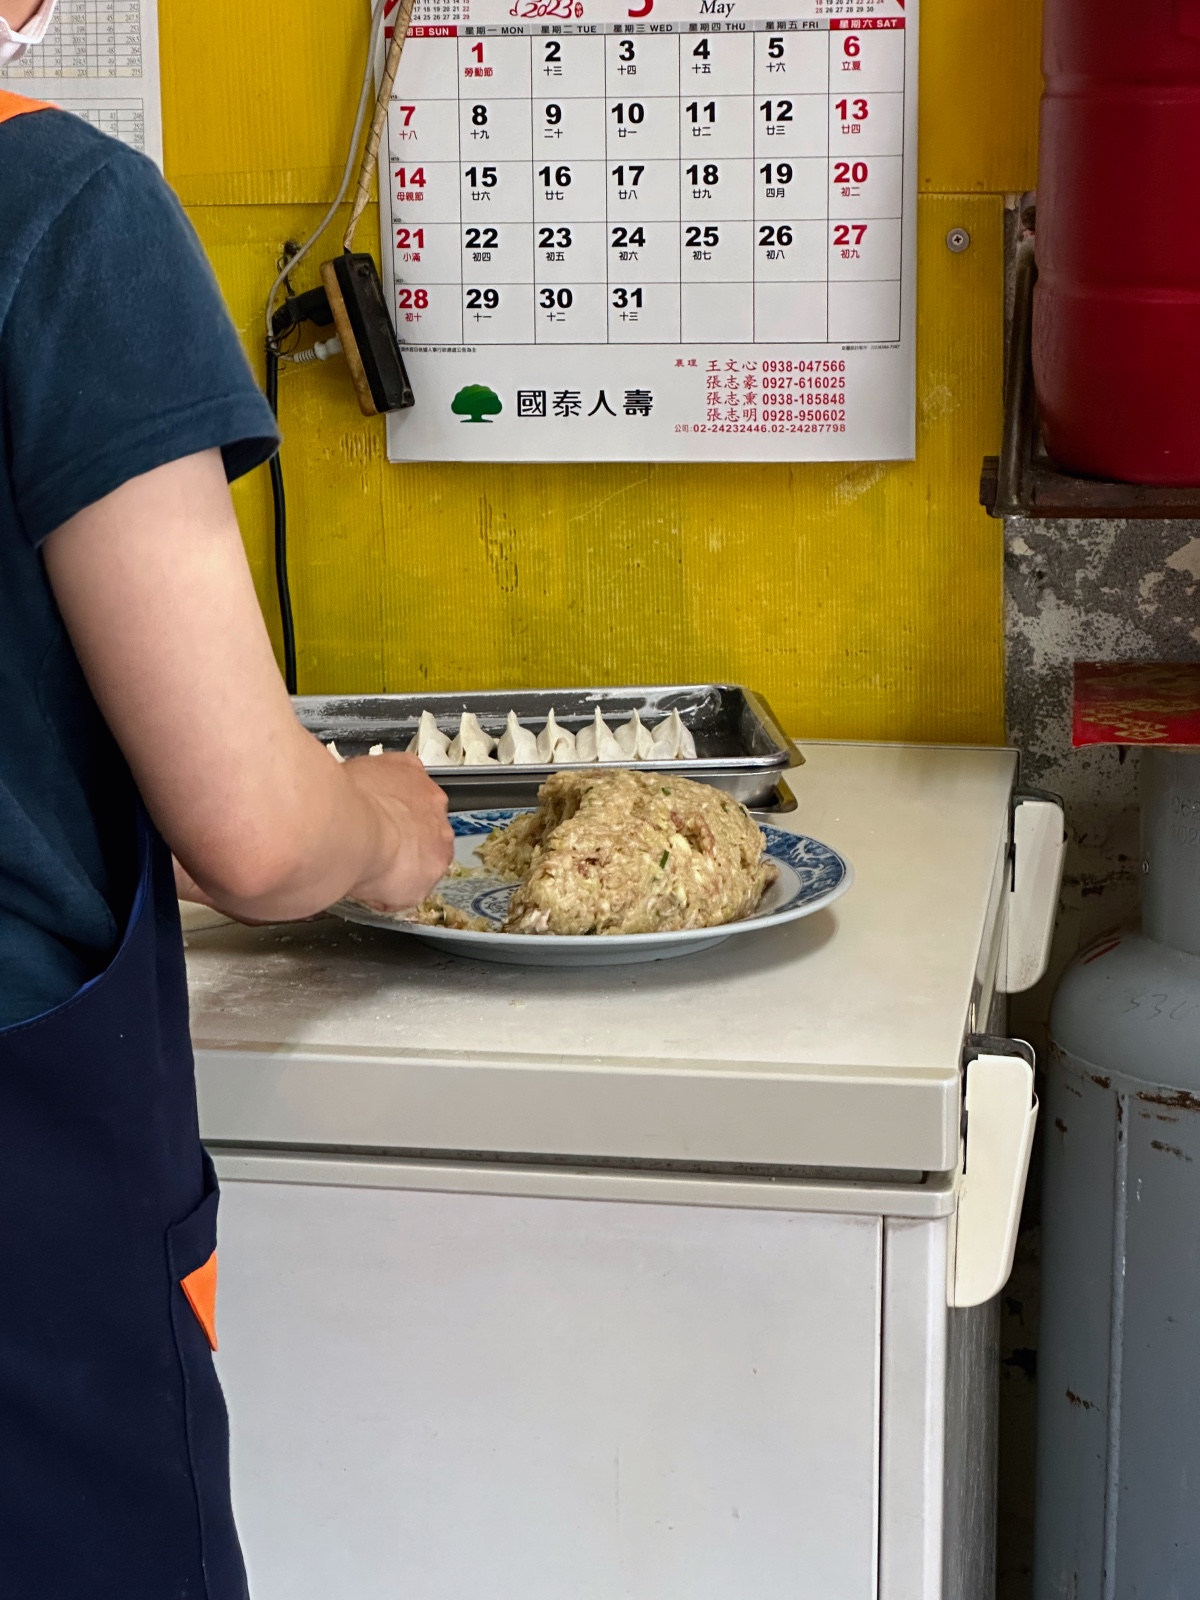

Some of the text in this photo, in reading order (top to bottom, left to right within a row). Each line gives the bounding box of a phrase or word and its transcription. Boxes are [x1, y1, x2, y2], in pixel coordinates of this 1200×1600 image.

[520, 0, 573, 18] 2023
[700, 0, 736, 17] May
[428, 27, 449, 36] SUN
[465, 26, 497, 35] 星期一
[501, 26, 524, 34] MON
[541, 25, 573, 34] 星期二
[577, 25, 597, 33] TUE
[613, 24, 646, 33] 星期三
[650, 24, 673, 32] WED
[689, 22, 721, 32] 星期四
[725, 23, 746, 31] THU
[766, 21, 798, 30] 星期五
[802, 21, 819, 29] FRI
[839, 19, 873, 29] 星期六
[876, 19, 897, 28] SAT
[472, 36, 860, 63] 1 2 3 4 5 6
[465, 60, 861, 78] 勞動節 十三 十四 十五 十六 立夏
[400, 99, 868, 126] 7 8 9 10 11 12 13
[399, 123, 861, 141] 十八 十九 二十 廿一 廿二 廿三 廿四
[395, 162, 868, 187] 14 15 16 17 18 19 20
[397, 186, 860, 202] 母親節 廿六 廿七 廿八 廿九 四月 初二
[397, 225, 867, 248] 21 22 23 24 25 26 27
[403, 248, 860, 263] 小滿 初四 初五 初六 初七 初八 初九
[399, 288, 642, 309] 28 29 30 31
[405, 311, 639, 323] 初十 十一 十二 十三
[674, 359, 846, 372] 襄理 王文心 0938-047566
[706, 374, 846, 390] 張志豪 0927-616025
[517, 389, 653, 418] 國泰人壽
[762, 393, 846, 405] 0938-185848
[706, 408, 846, 422] 張志明 0928-950602
